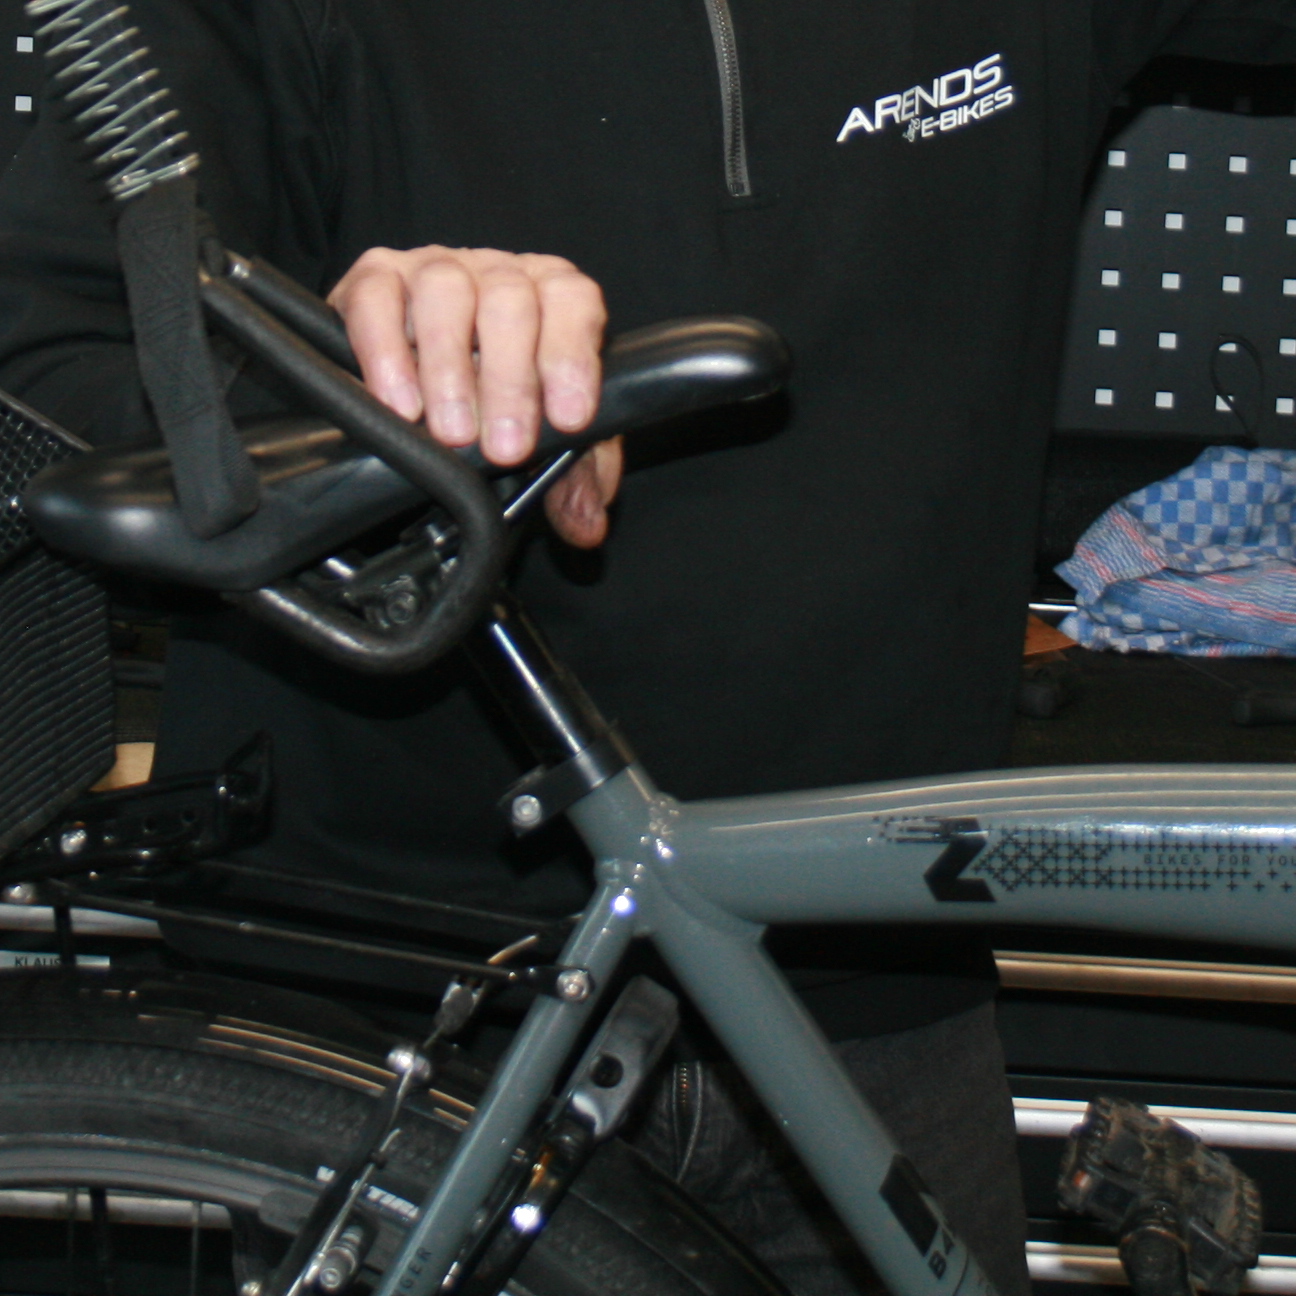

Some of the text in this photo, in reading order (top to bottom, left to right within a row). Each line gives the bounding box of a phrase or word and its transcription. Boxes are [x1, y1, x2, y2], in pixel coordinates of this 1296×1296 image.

[836, 53, 1002, 142] ARENDS
[920, 85, 1013, 138] E-BIKES
[1143, 855, 1202, 865] BIKES
[1216, 855, 1251, 865] FOR
